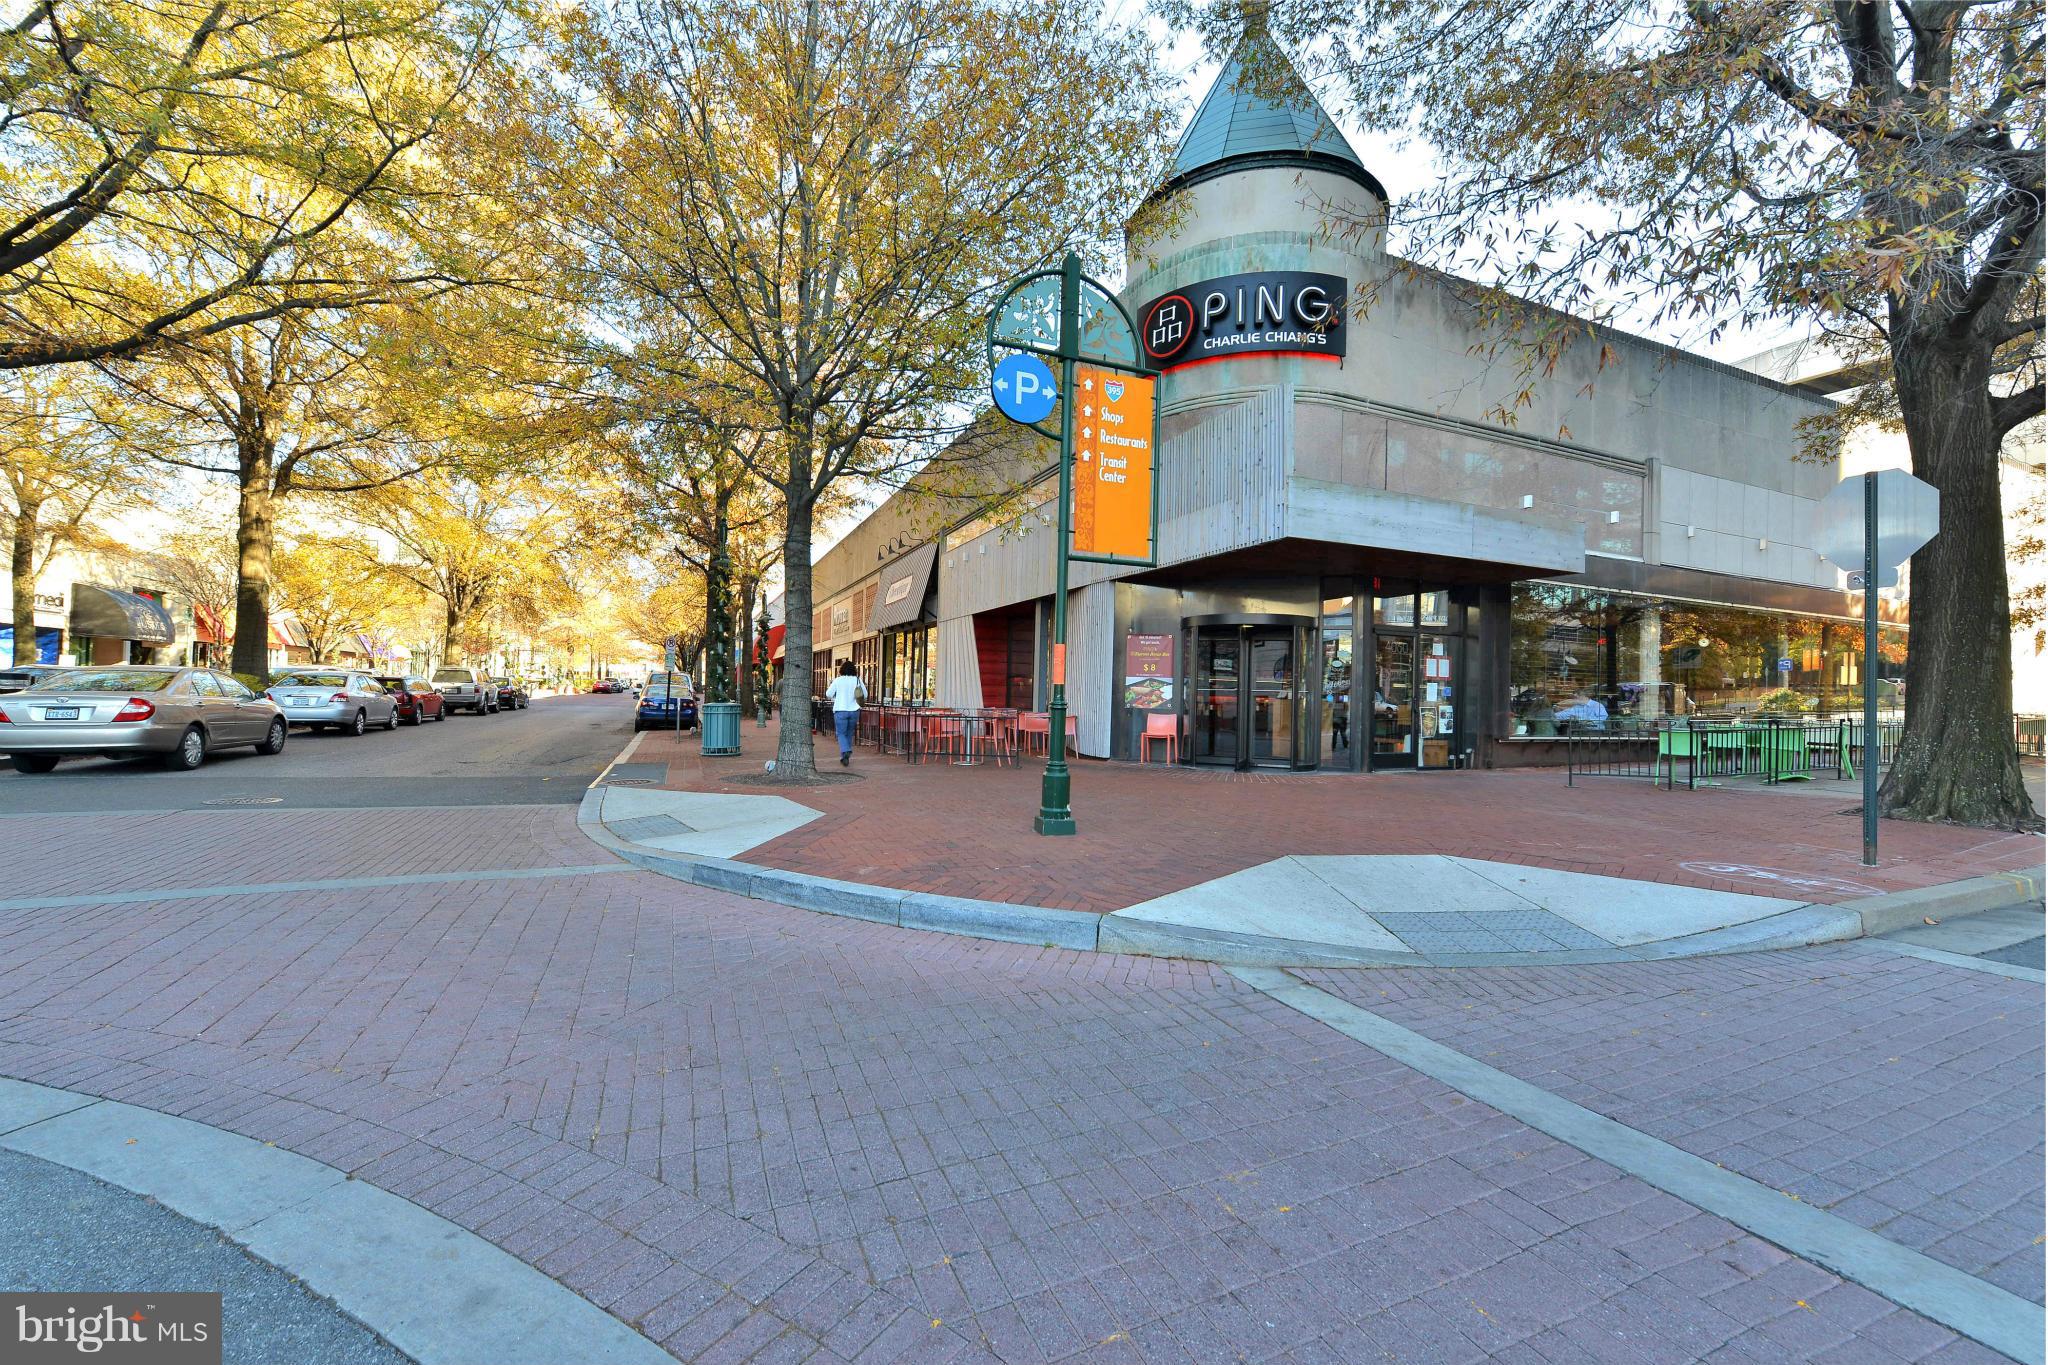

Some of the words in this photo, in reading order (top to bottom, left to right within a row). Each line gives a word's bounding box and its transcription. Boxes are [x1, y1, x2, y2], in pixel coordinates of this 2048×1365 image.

[1203, 282, 1328, 332] PING
[1203, 332, 1261, 349] CHARLIE
[1015, 371, 1039, 405] P
[1107, 385, 1121, 396] 395
[1101, 406, 1124, 426] Shops
[1100, 428, 1148, 449] Restaurants
[1100, 451, 1127, 469] Transit
[1099, 467, 1126, 484] Center
